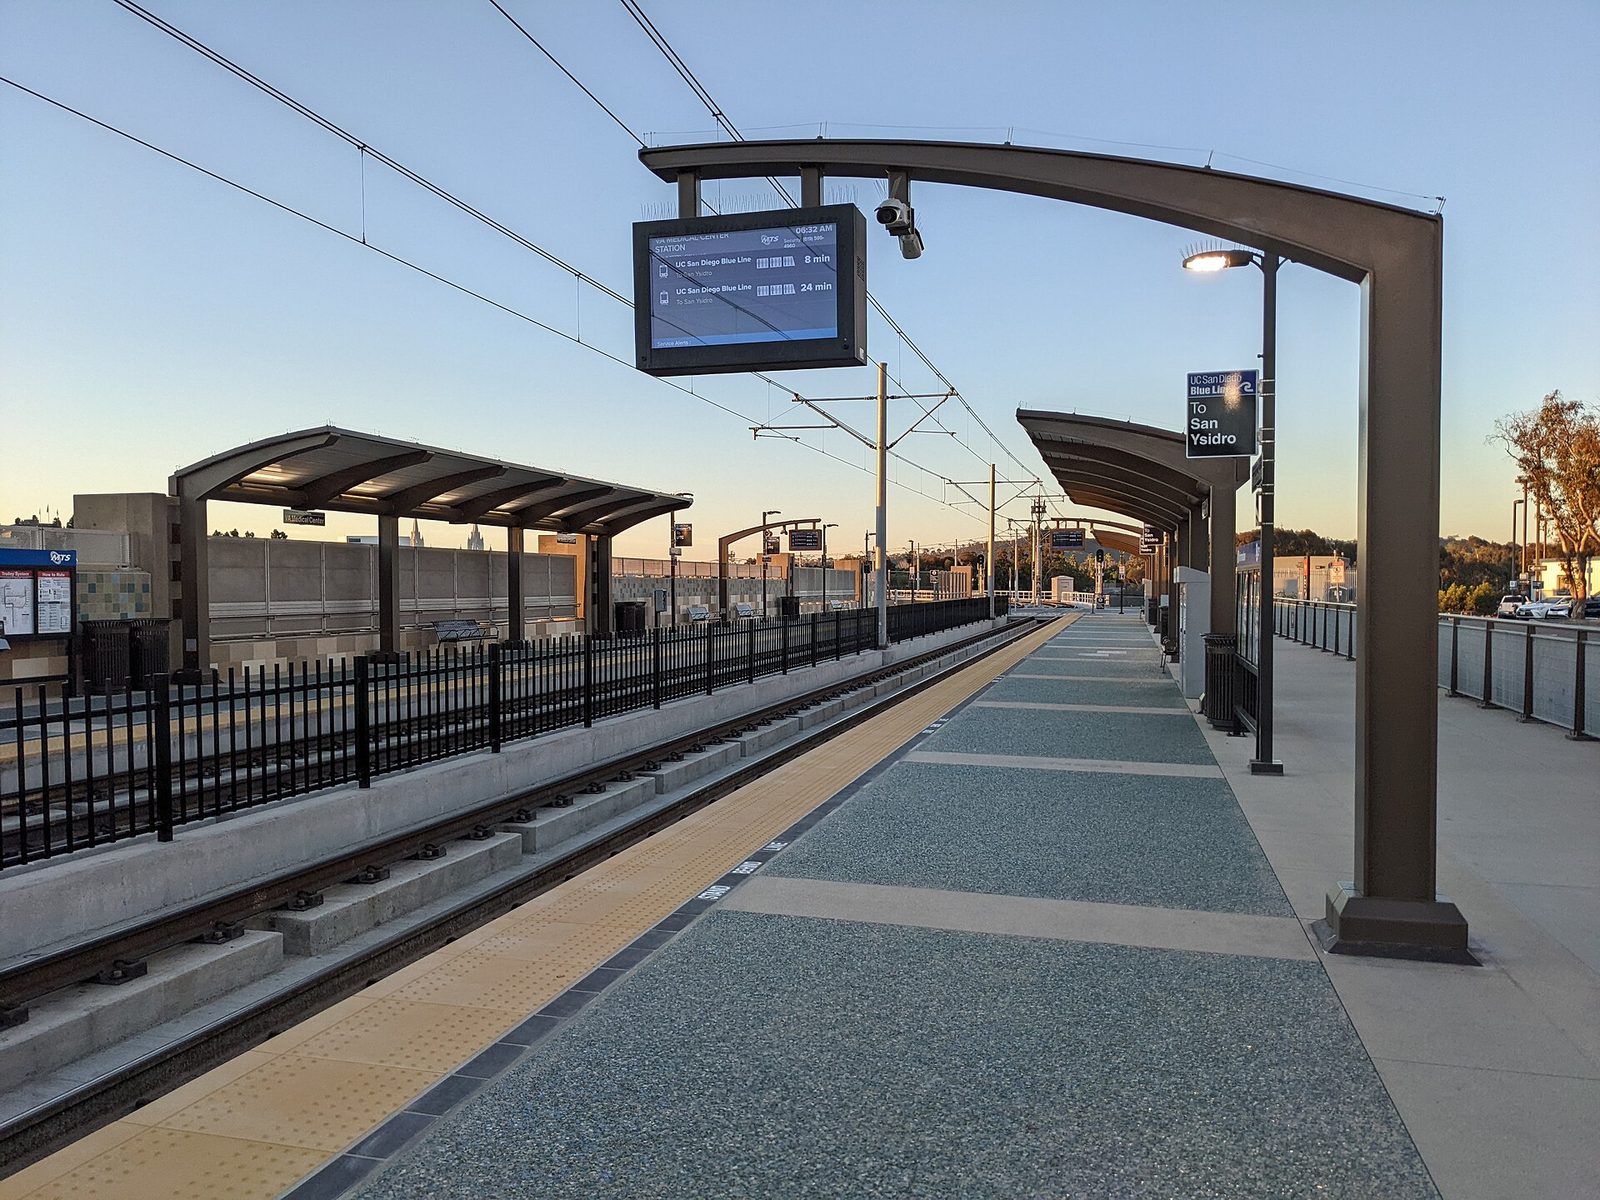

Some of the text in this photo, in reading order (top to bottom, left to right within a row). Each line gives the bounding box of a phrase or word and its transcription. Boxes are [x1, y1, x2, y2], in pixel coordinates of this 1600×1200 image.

[796, 226, 818, 234] 06:32
[655, 244, 686, 254] STATION
[701, 259, 720, 267] Diego
[804, 254, 830, 264] 8 min
[701, 286, 720, 294] Diego
[801, 282, 832, 292] 24 min
[1190, 375, 1202, 385] UC
[1202, 374, 1218, 384] San
[1190, 386, 1210, 395] Blue
[1190, 401, 1207, 414] To
[1190, 418, 1218, 430] San
[1190, 433, 1237, 446] Ysidro
[50, 551, 71, 565] MTS
